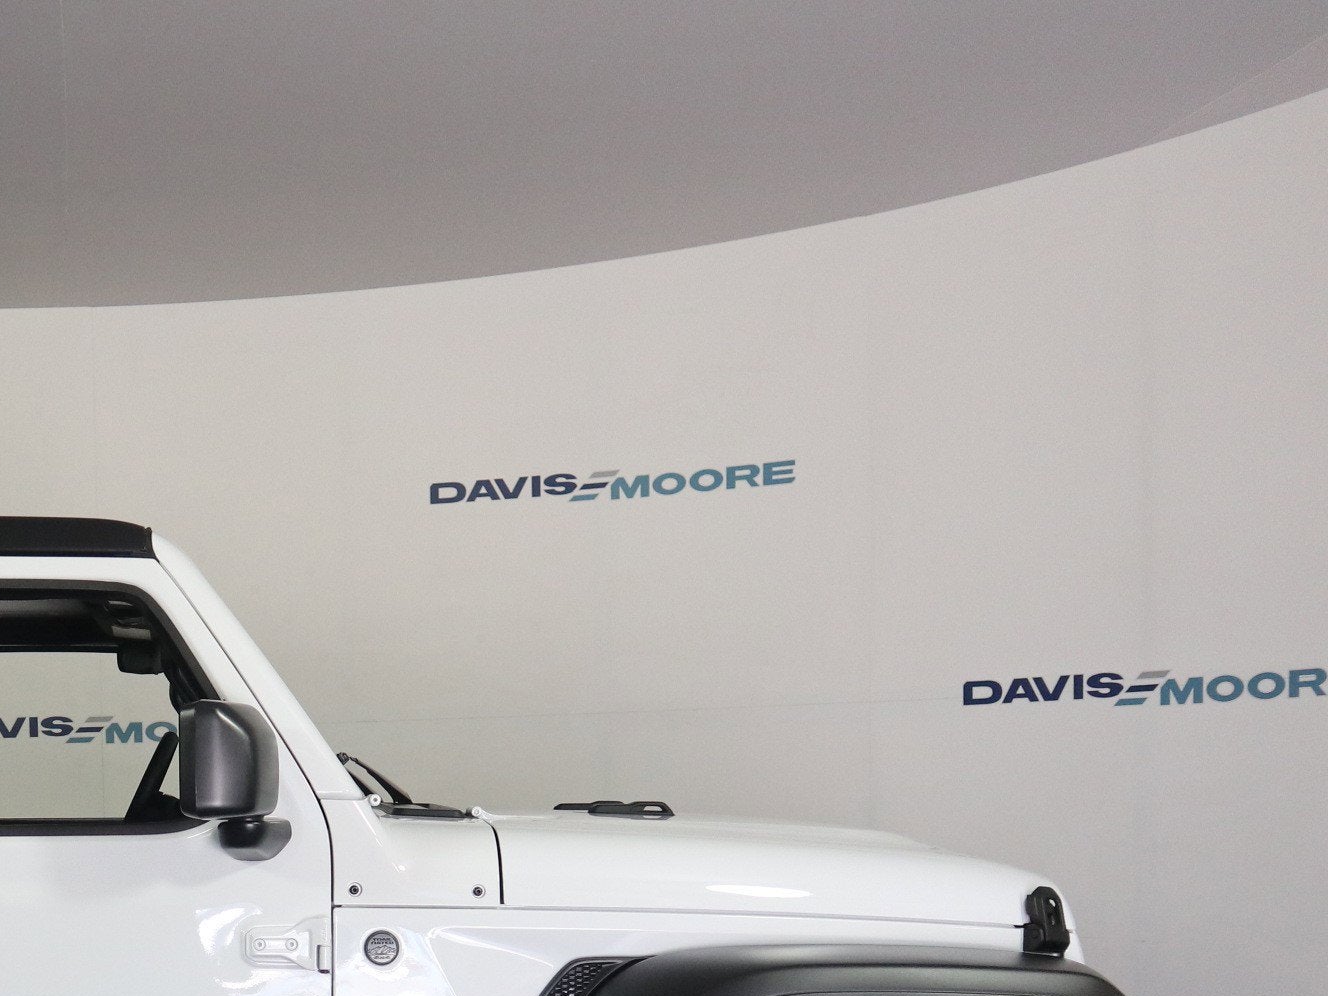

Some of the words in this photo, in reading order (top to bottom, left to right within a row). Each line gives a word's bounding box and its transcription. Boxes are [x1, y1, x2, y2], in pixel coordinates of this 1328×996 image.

[429, 472, 578, 505] DAVIS
[610, 459, 796, 500] MOORE
[962, 672, 1125, 706] DAVIS
